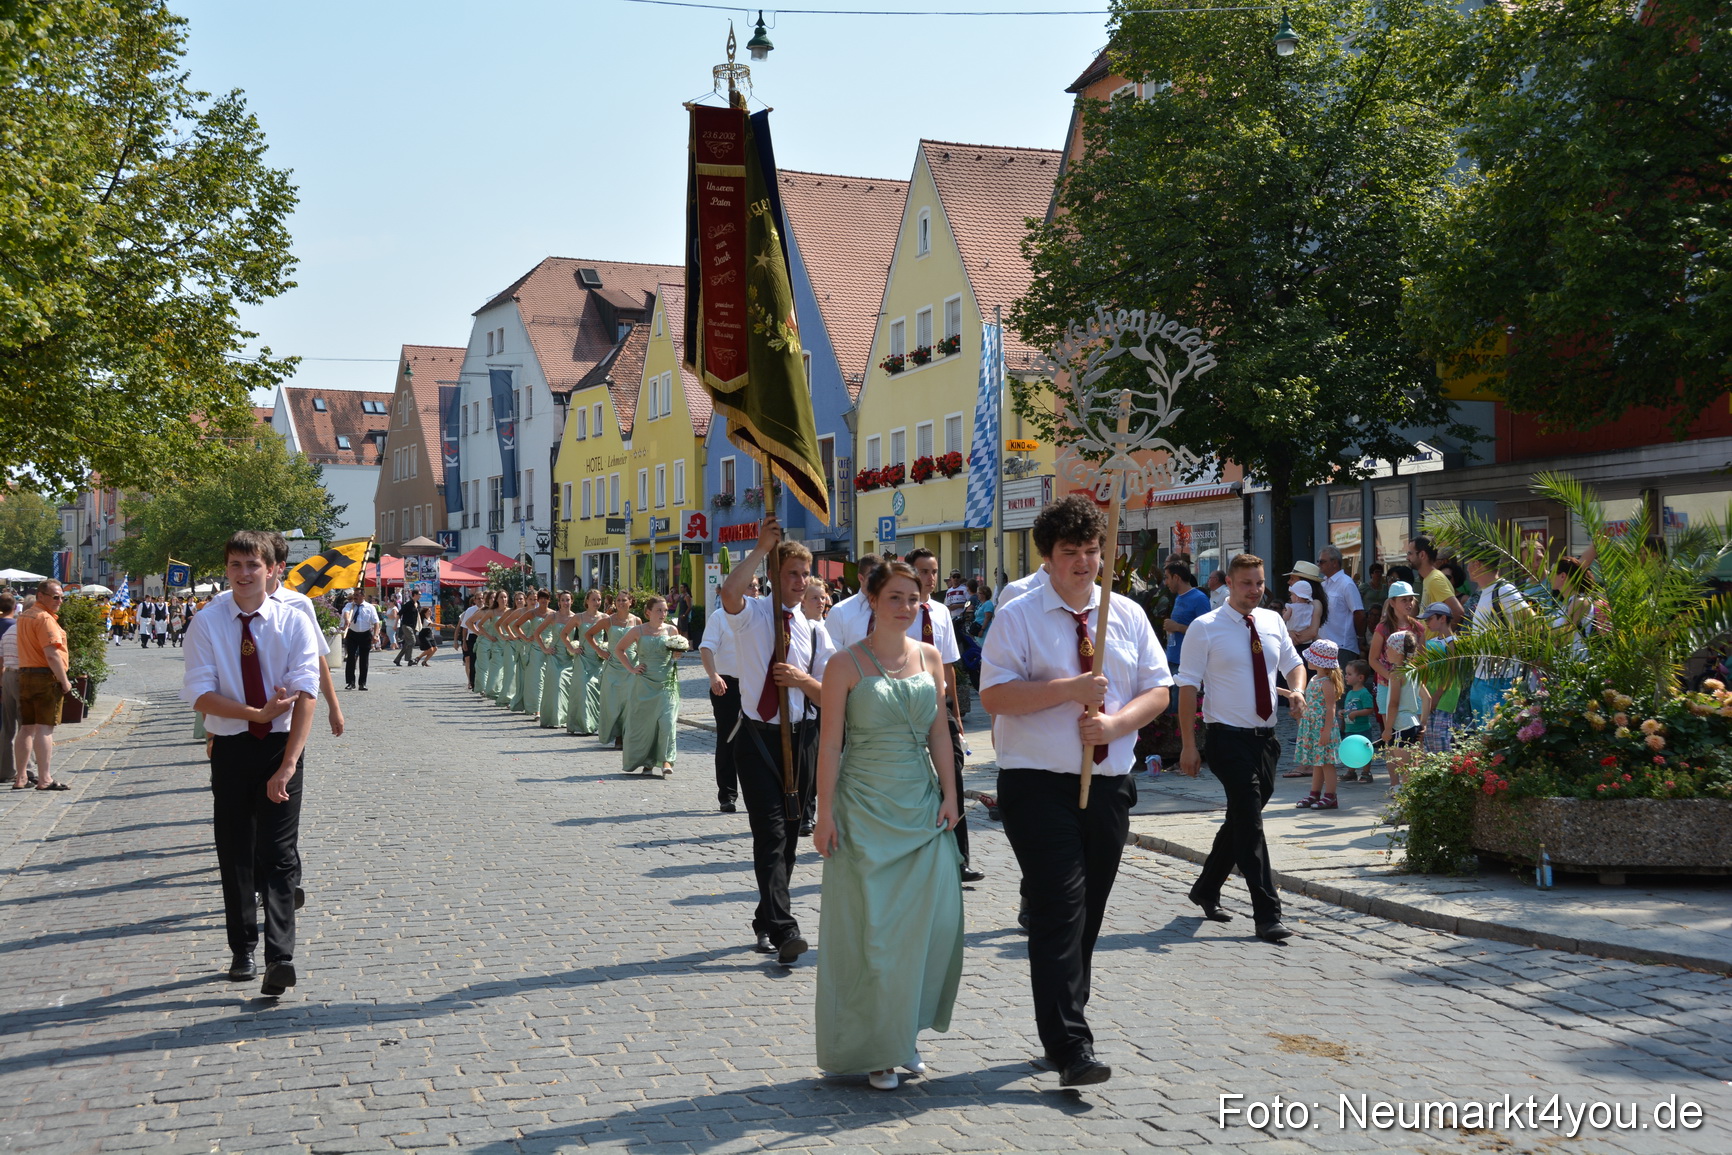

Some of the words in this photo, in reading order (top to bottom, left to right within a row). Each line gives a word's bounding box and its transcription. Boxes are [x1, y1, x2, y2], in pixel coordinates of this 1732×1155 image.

[702, 131, 736, 140] 23.6.2002
[710, 197, 731, 207] Paten
[714, 251, 731, 266] Dank
[585, 456, 604, 473] HOTEL
[607, 453, 628, 468] Lehmeier
[1024, 497, 1036, 508] KINO
[882, 519, 892, 539] P
[584, 535, 609, 547] Restaurant
